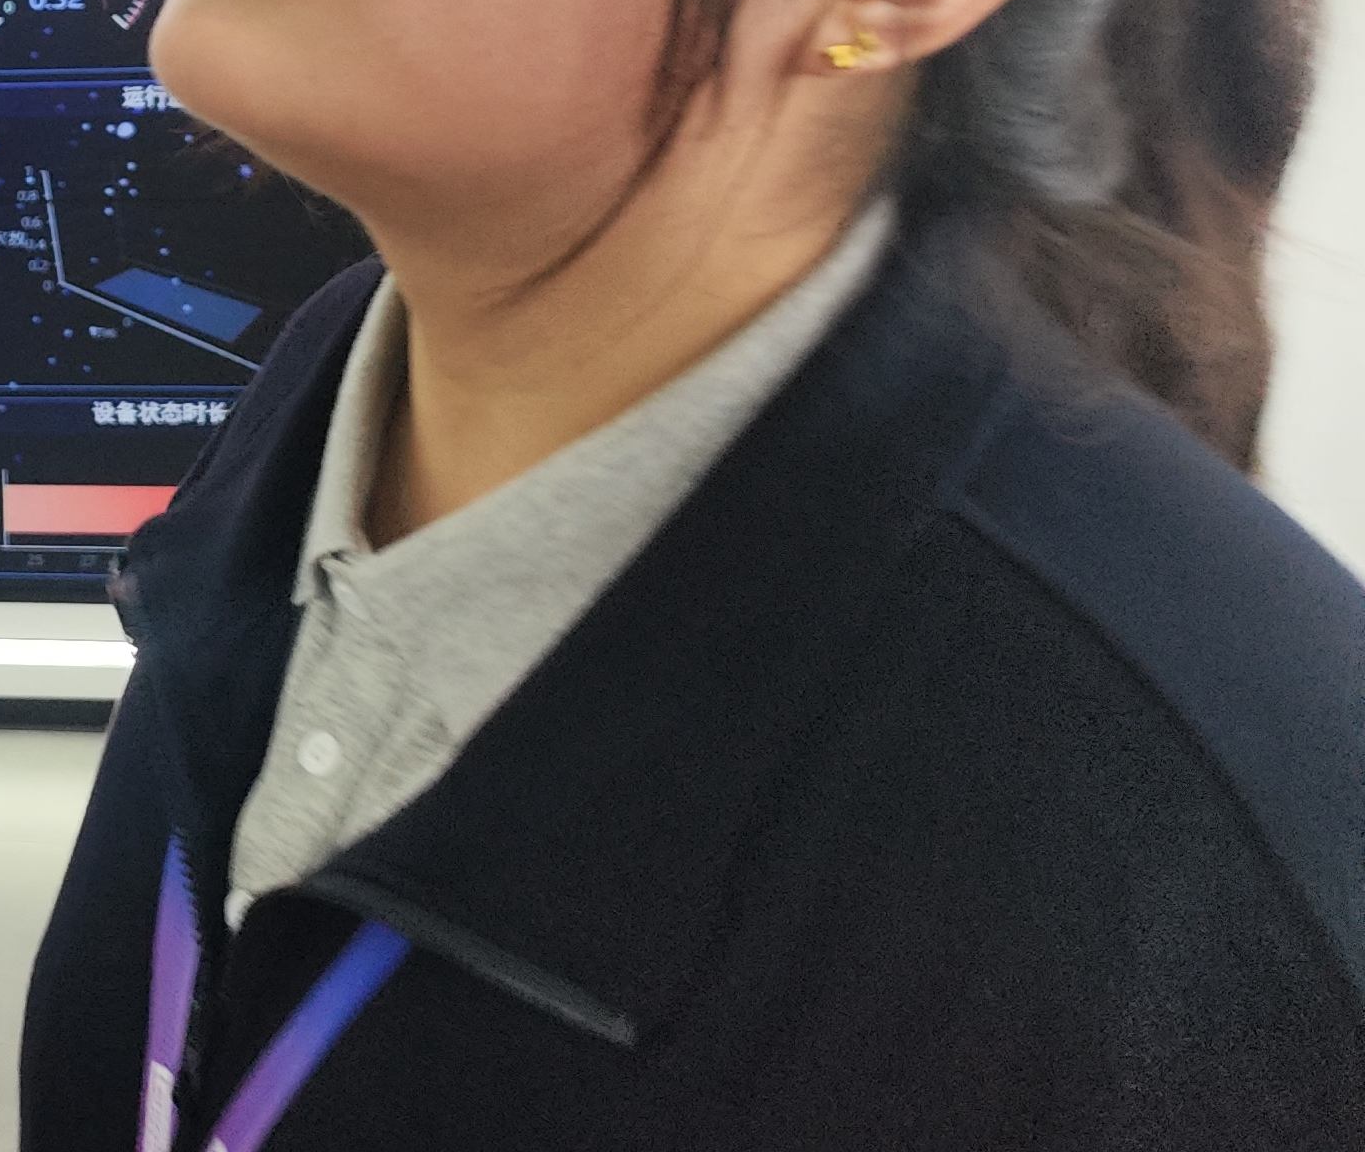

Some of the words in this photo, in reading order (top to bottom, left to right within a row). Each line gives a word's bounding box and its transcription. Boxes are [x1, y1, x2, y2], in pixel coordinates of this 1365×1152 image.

[92, 400, 230, 426] 设备状态时长
